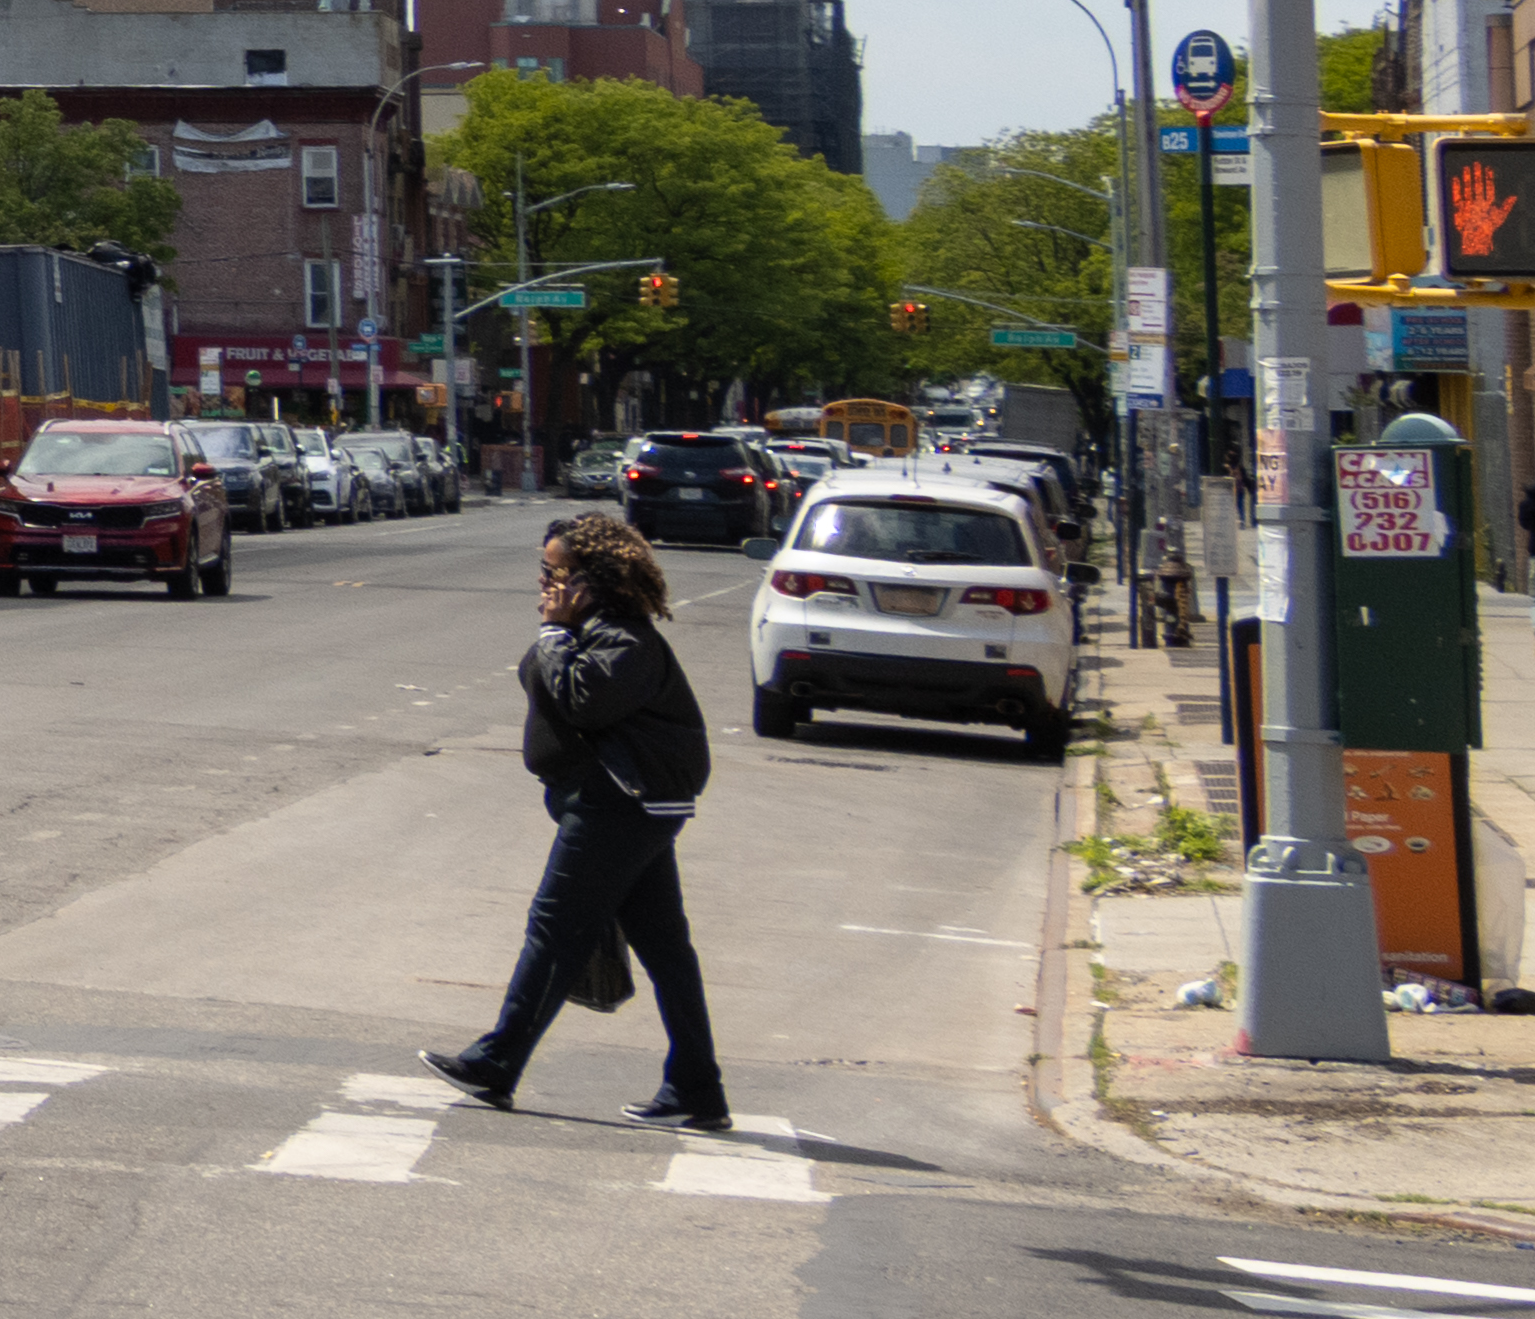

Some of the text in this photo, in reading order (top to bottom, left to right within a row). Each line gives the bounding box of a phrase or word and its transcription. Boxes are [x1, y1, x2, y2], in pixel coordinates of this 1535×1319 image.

[1162, 131, 1189, 150] B25
[226, 347, 269, 361] FRUIT
[272, 348, 284, 361] &
[1350, 489, 1422, 511] (516)
